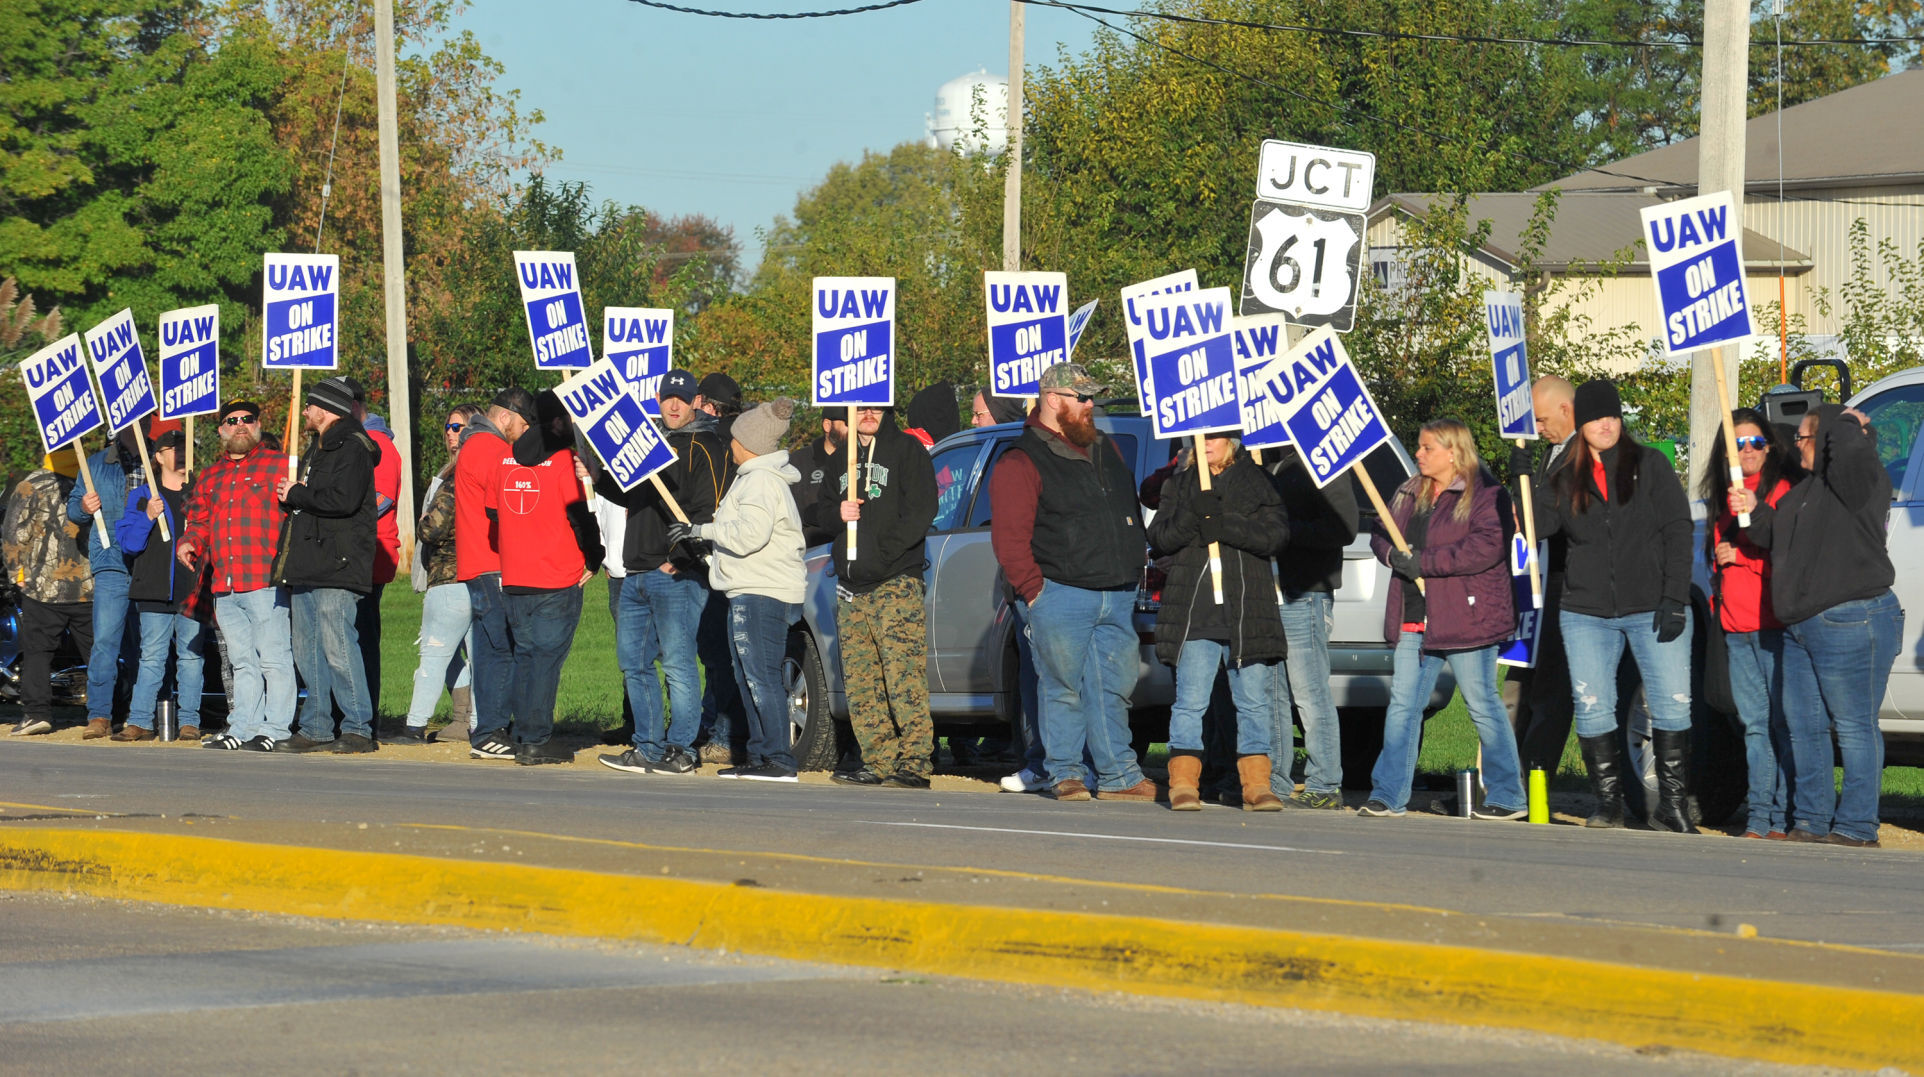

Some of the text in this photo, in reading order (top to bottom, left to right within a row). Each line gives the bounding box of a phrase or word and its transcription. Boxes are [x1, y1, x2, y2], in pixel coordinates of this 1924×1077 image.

[1270, 155, 1362, 198] JCT
[1650, 204, 1727, 254] UAW
[268, 264, 332, 291] UAW
[520, 262, 572, 290] UAW
[1269, 234, 1326, 298] 61
[1686, 255, 1717, 300] ON
[288, 300, 313, 330] ON
[545, 299, 568, 330] ON
[818, 289, 889, 319] UAW
[990, 284, 1060, 313] UAW
[1668, 278, 1743, 346] STRIKE
[163, 315, 215, 346] UAW
[608, 317, 668, 343] UAW
[1015, 323, 1042, 355] ON
[1146, 301, 1224, 340] UAW
[1488, 304, 1522, 339] UAW
[90, 320, 133, 362] UAW
[269, 322, 332, 362] STRIKE
[536, 322, 586, 363] STRIKE
[840, 329, 867, 363] ON
[1235, 325, 1279, 359] AW
[26, 343, 76, 388] UAW
[114, 357, 133, 390] ON
[179, 351, 200, 381] ON
[626, 352, 649, 380] ON
[819, 353, 888, 399] STRIKE
[1177, 347, 1209, 386] ON
[1266, 337, 1338, 404] UAW
[1505, 351, 1521, 388] ON
[53, 380, 75, 412] ON
[110, 370, 149, 426] STRIKE
[165, 369, 215, 413] STRIKE
[564, 369, 621, 418] UAW
[1159, 371, 1236, 429] STRIKE
[1311, 386, 1343, 431] ON
[46, 389, 95, 445] STRIKE
[604, 410, 631, 445] ON
[1243, 398, 1280, 436] RIK
[1310, 394, 1374, 476] STRIKE
[611, 421, 659, 483] STRIKE
